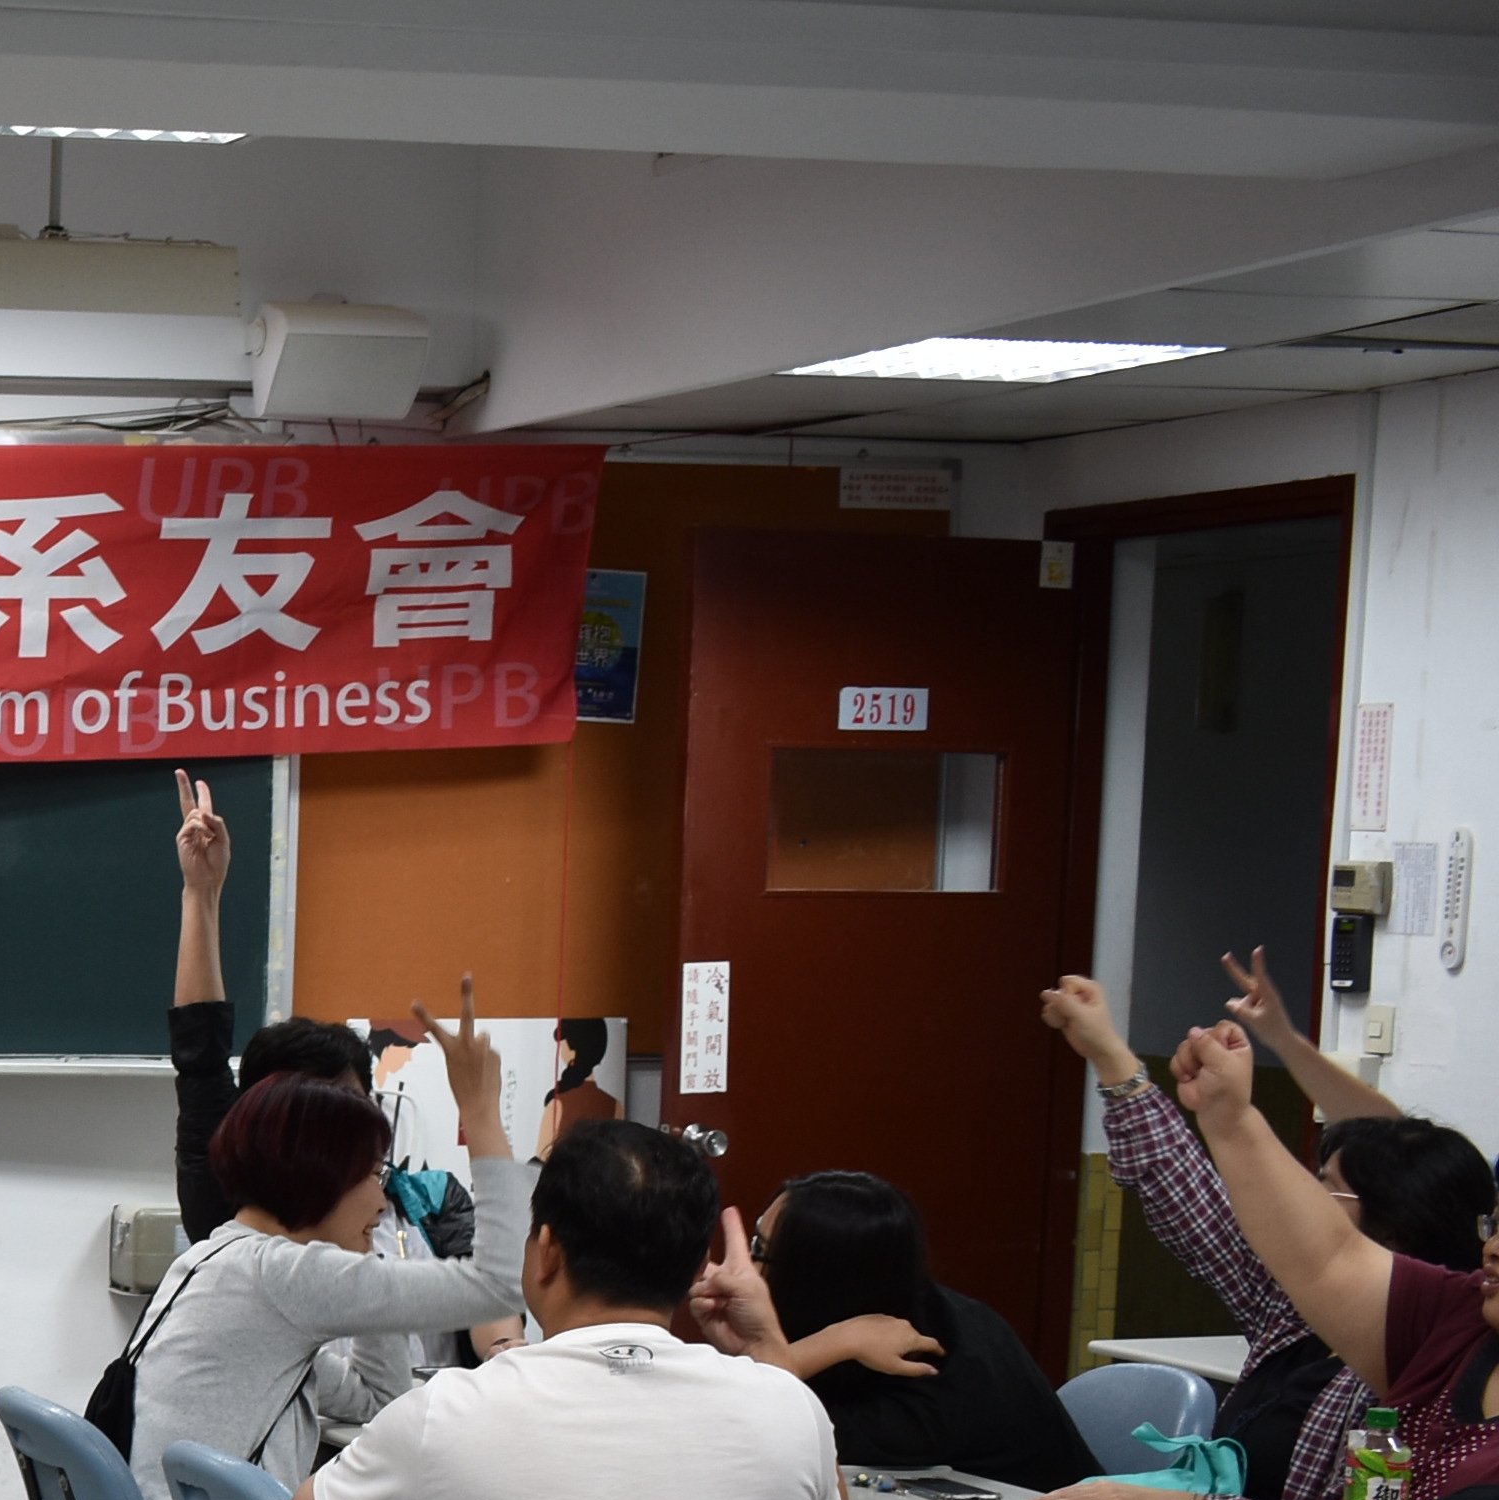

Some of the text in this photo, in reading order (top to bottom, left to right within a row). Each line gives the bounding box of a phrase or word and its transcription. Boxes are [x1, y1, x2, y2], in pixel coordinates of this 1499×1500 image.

[137, 457, 310, 526] UPB
[71, 670, 143, 734] of
[157, 671, 432, 732] Business
[852, 692, 917, 725] 2519
[703, 966, 726, 1089] 冷氣開放
